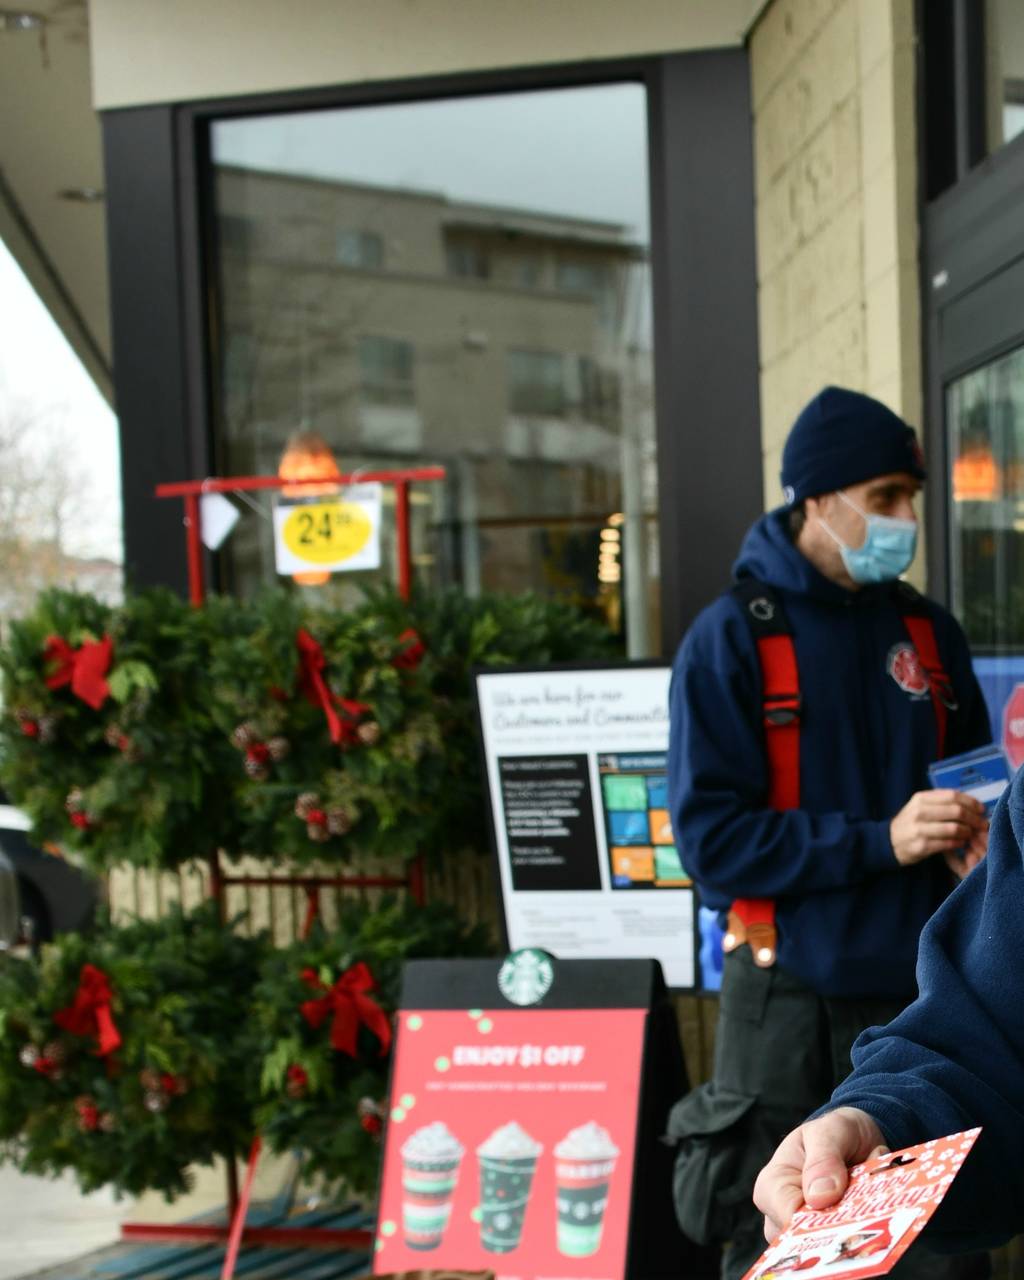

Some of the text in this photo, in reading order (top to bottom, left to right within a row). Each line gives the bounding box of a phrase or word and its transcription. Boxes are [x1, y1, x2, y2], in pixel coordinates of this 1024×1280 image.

[453, 1045, 518, 1066] ENJOY
[544, 1045, 585, 1066] OFF
[843, 1171, 916, 1201] Happy
